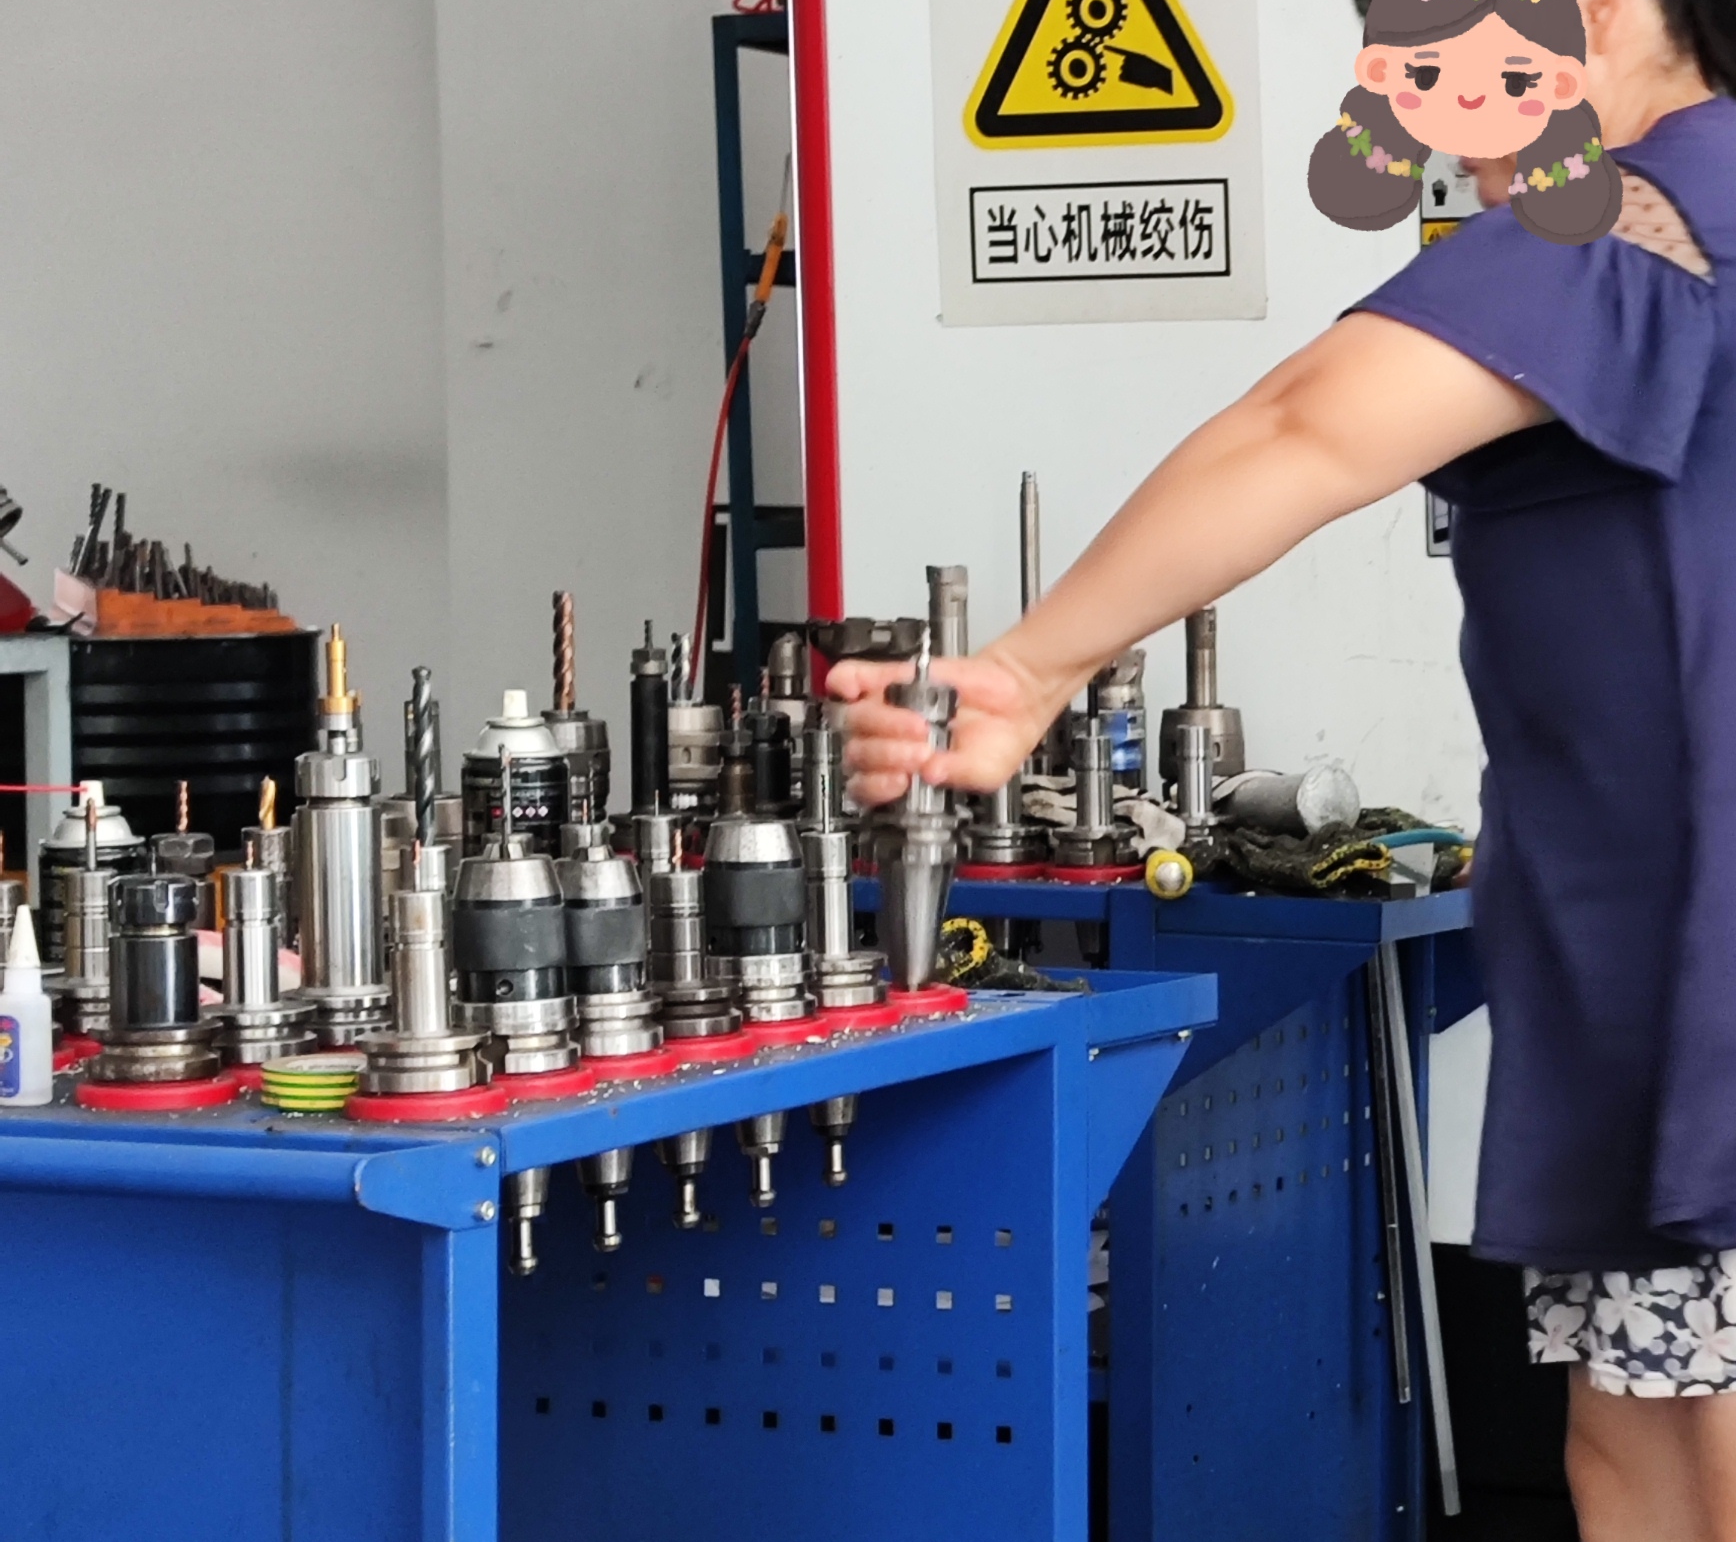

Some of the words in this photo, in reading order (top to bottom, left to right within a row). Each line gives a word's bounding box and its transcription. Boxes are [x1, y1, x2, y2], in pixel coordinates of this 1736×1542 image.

[987, 198, 1214, 264] 当心机械绞伤
